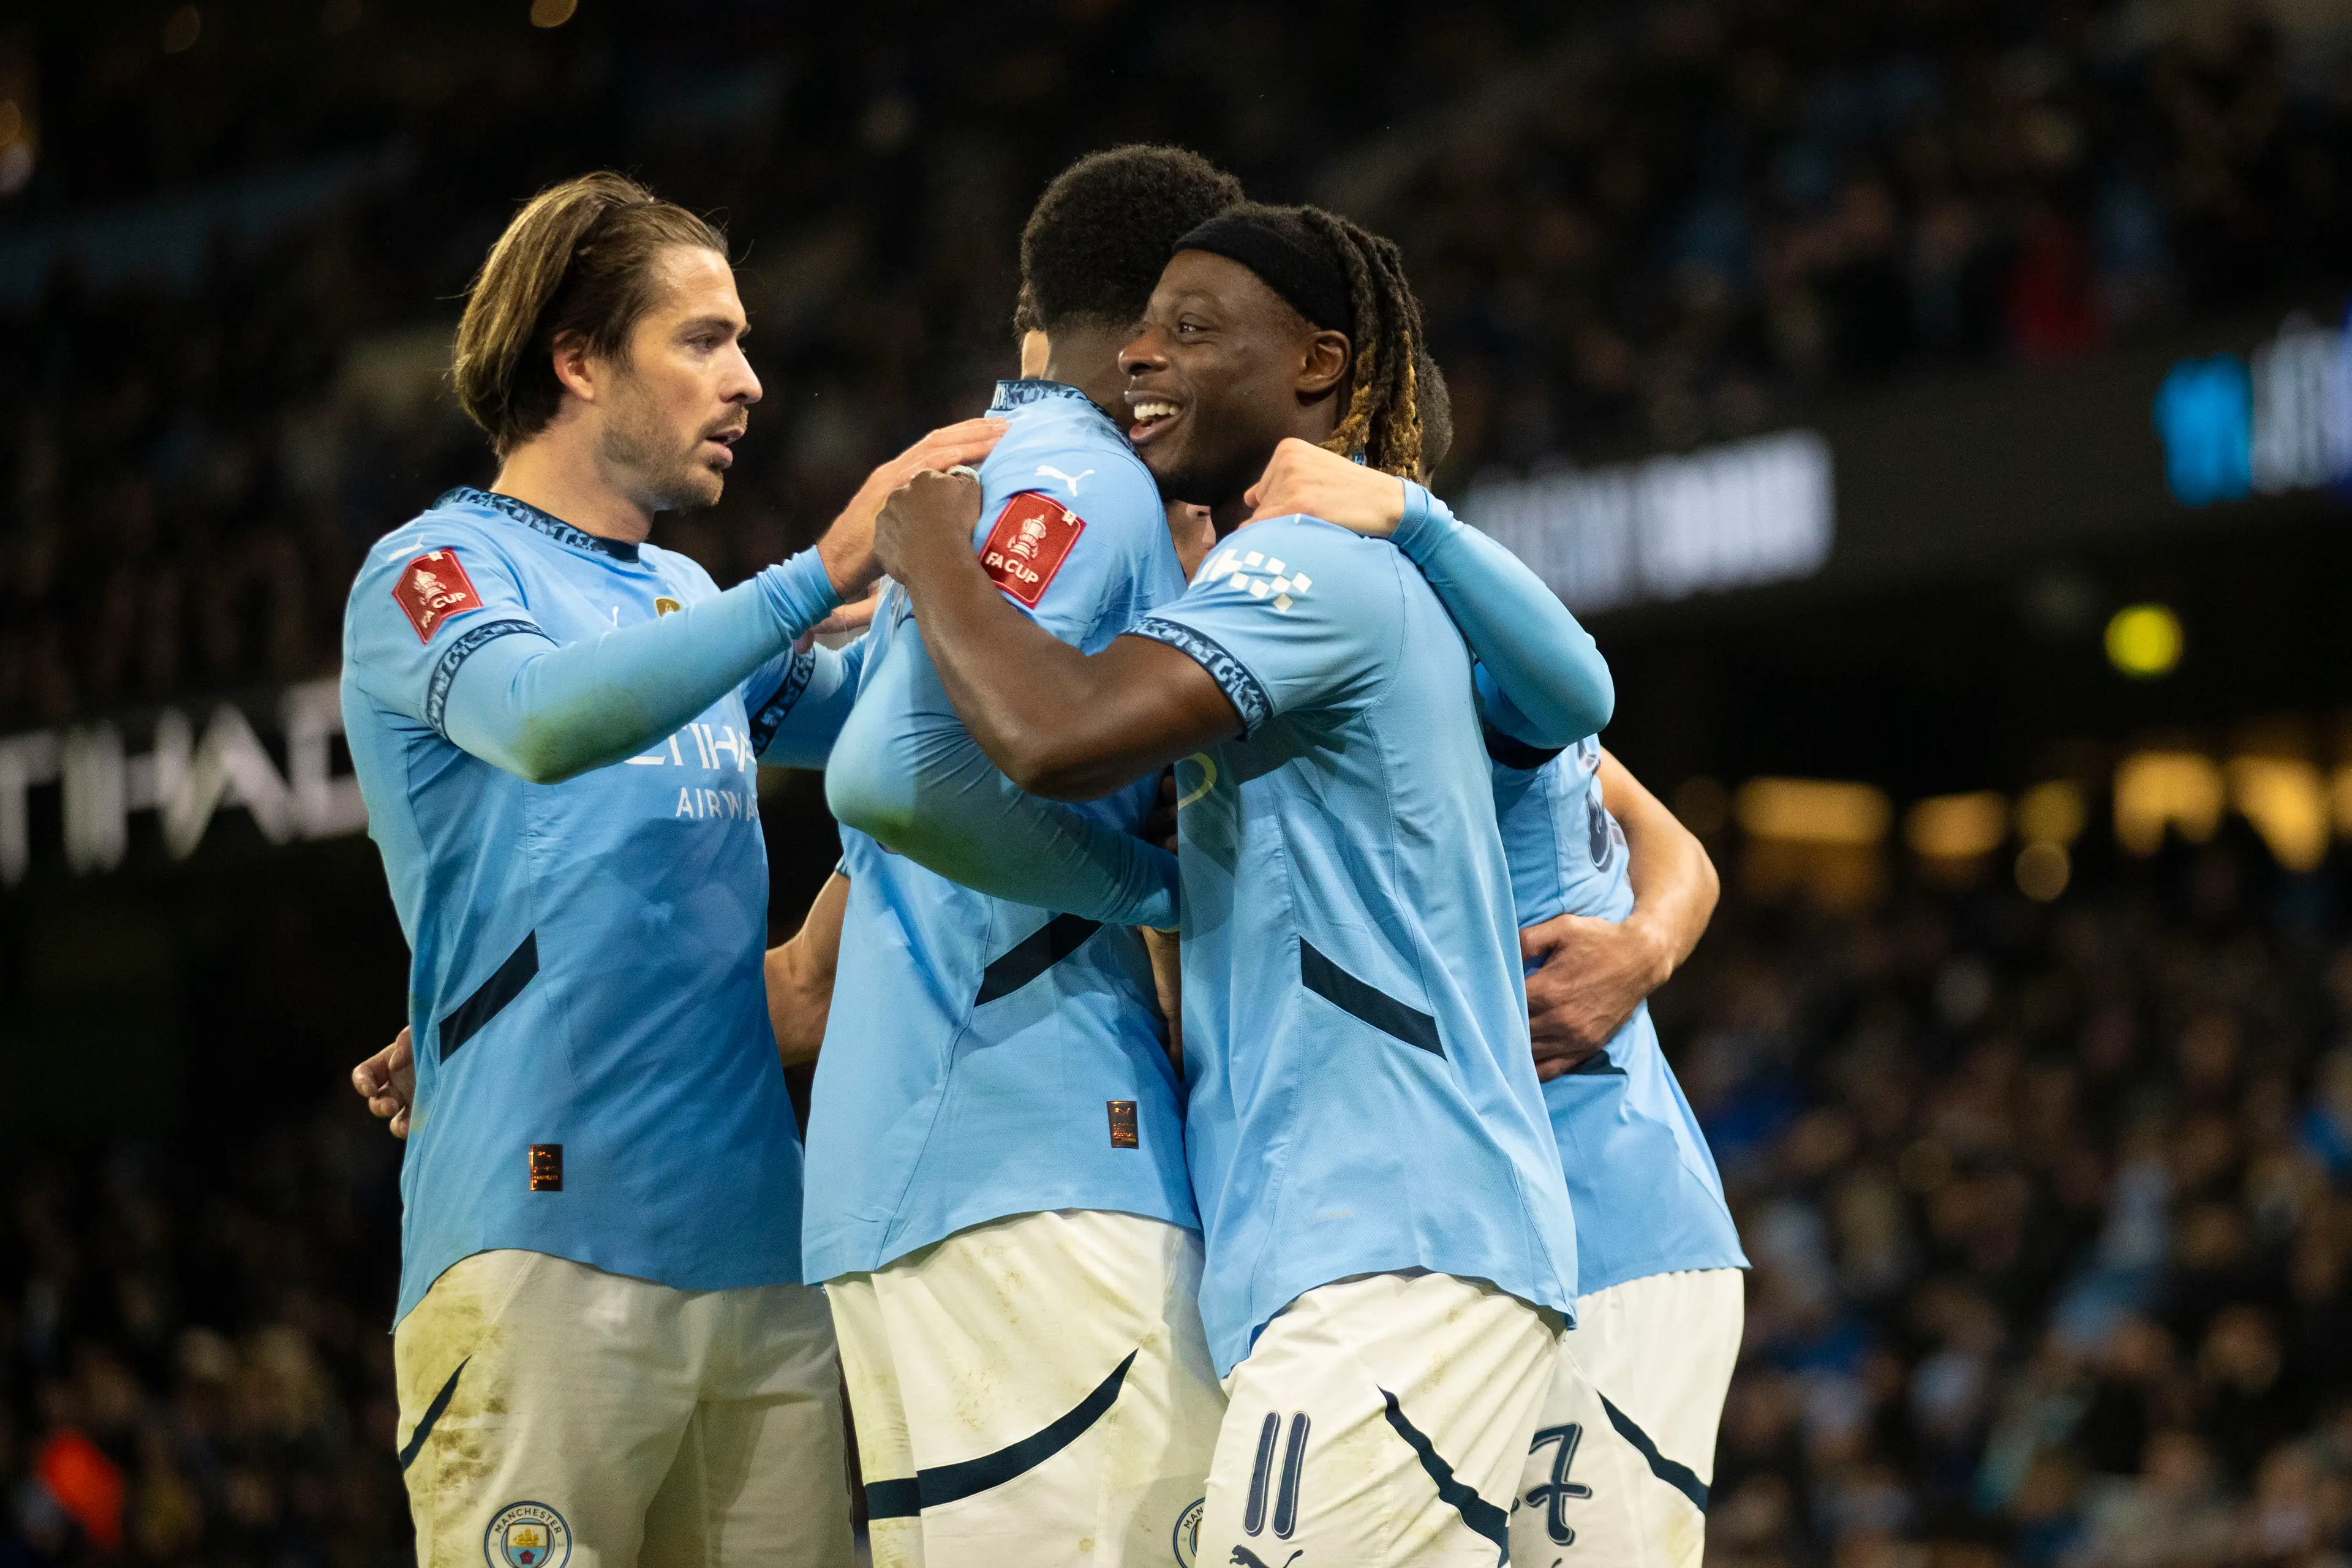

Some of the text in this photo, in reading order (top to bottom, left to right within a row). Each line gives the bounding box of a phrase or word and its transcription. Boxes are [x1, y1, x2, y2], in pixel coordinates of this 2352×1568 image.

[985, 551, 1039, 584] FA CUP
[432, 592, 466, 608] CUP
[1243, 1410, 1311, 1540] 11
[1510, 1420, 1593, 1547] 7
[494, 1507, 562, 1534] MANCHESTER
